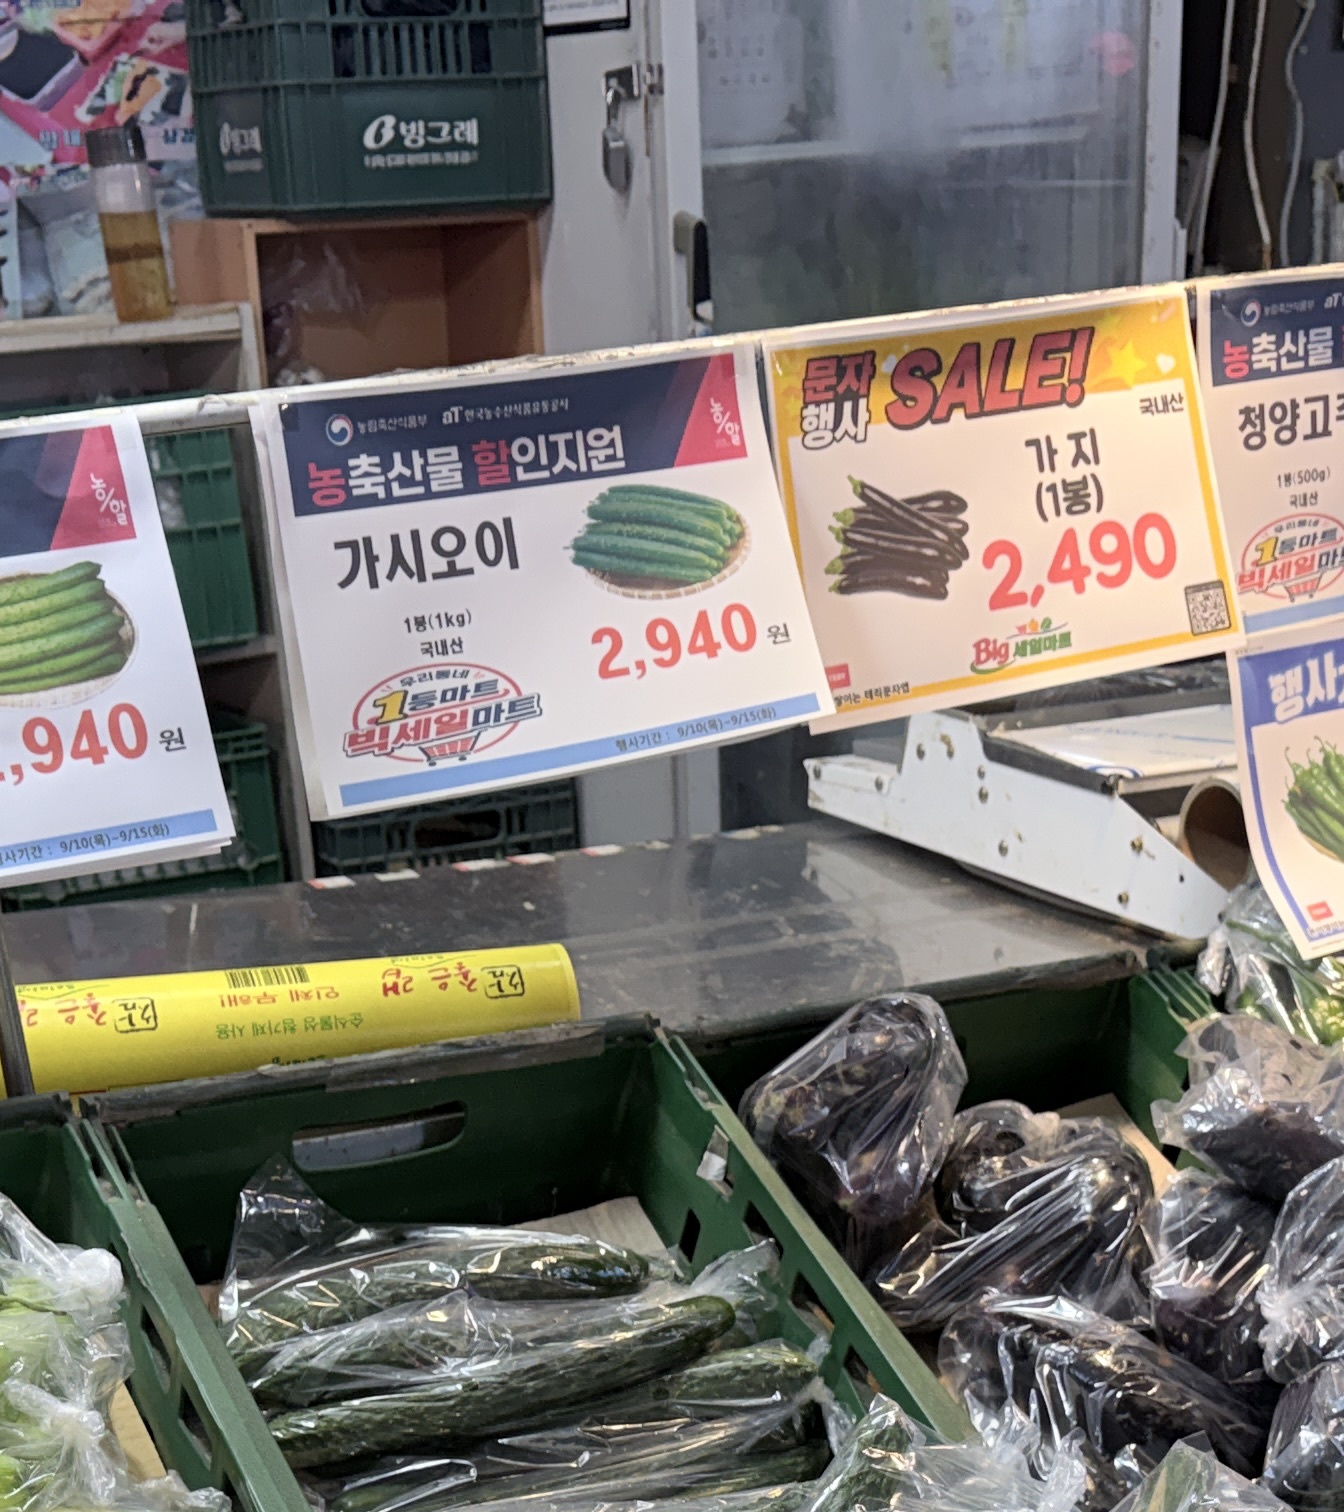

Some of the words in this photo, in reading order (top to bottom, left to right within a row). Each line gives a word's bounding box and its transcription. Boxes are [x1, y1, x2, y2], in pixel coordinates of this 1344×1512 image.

[399, 117, 479, 149] 빙그레
[1223, 326, 1333, 380] 농축산물
[803, 351, 876, 400] 문자
[884, 327, 1096, 431] SALE!
[442, 405, 463, 425] aT
[1139, 395, 1184, 416] 국내산
[800, 398, 870, 450] 행사
[307, 445, 463, 507] 농축산물
[471, 425, 625, 486] 할인지원
[1034, 472, 1104, 522] (1봉)
[1290, 493, 1318, 508] 국내산
[333, 516, 520, 590] 가시오이
[981, 512, 1177, 612] 2,490
[1255, 527, 1341, 566] 1등마트
[403, 608, 472, 634] 1봉(1kg)
[420, 636, 464, 659] 국내산
[591, 603, 757, 680] 2,940
[767, 622, 792, 645] 원
[972, 636, 1009, 664] Big
[400, 668, 470, 688] 우리동네
[373, 676, 501, 725] 1등마트
[158, 729, 188, 753] 원
[343, 693, 542, 757] 빅세일마트
[289, 985, 339, 1002] 인체
[428, 961, 477, 994] 좋은
[57, 993, 107, 1026] 좋은
[215, 1022, 244, 1040] 사용
